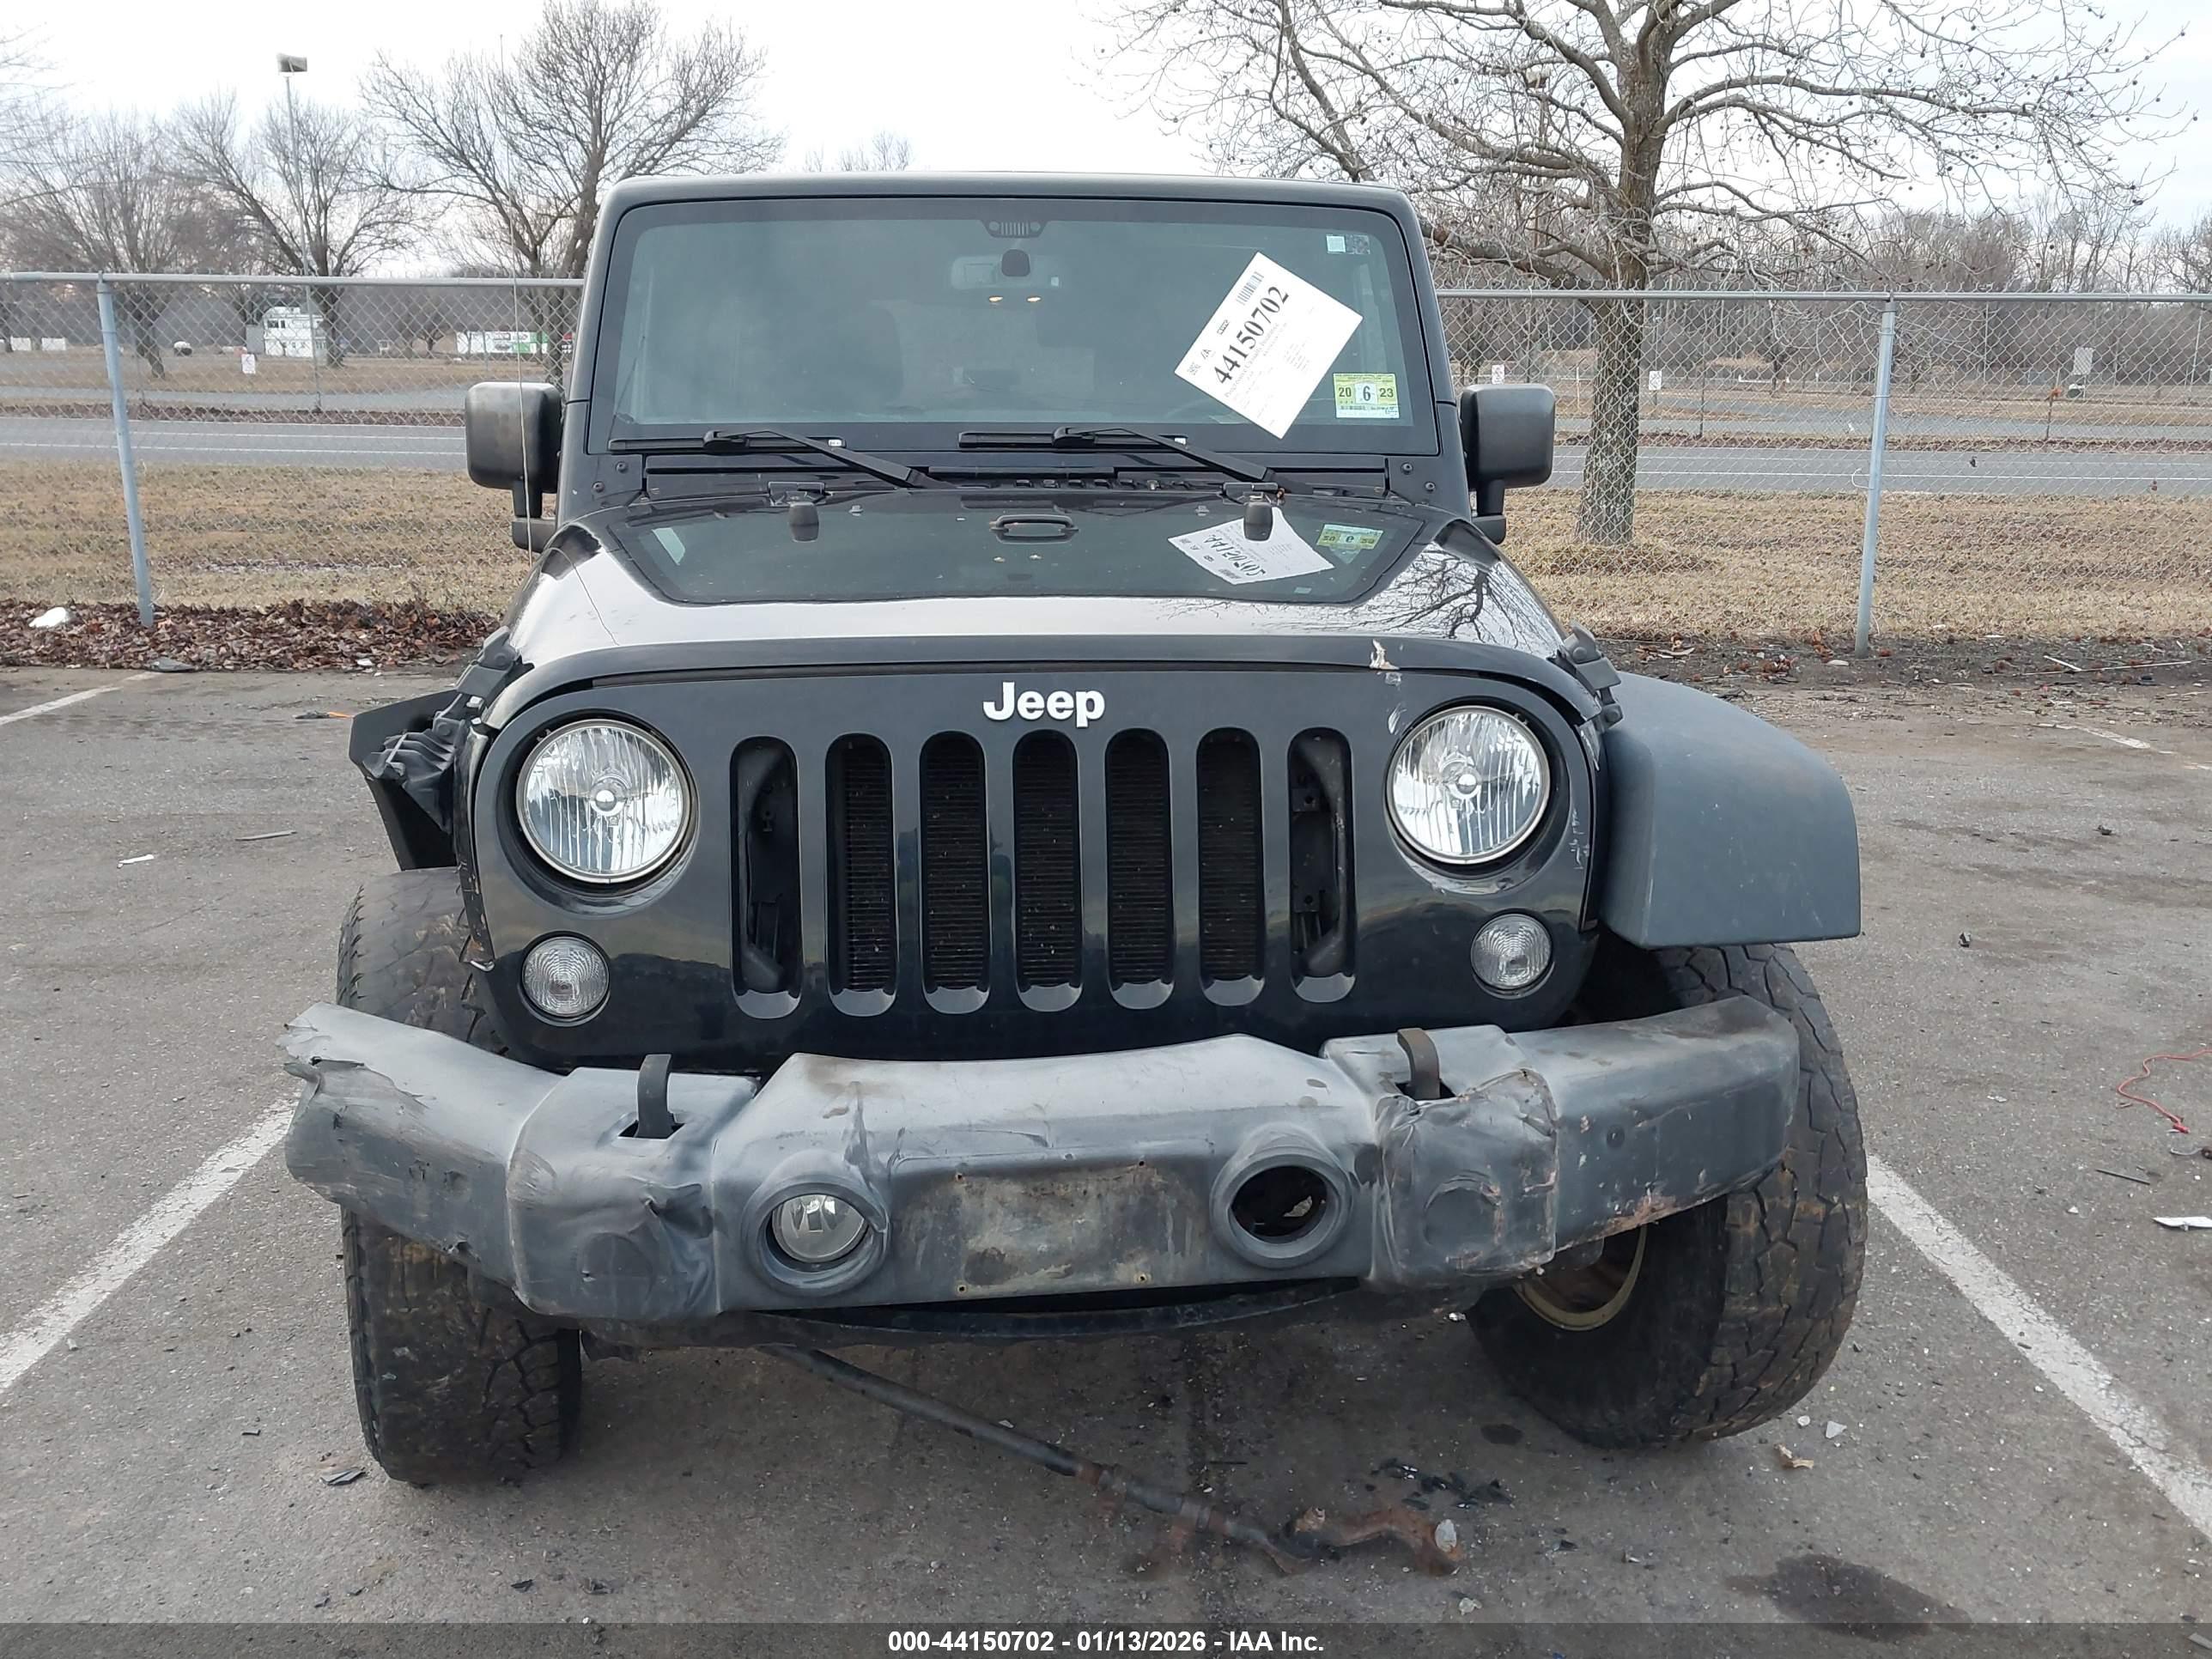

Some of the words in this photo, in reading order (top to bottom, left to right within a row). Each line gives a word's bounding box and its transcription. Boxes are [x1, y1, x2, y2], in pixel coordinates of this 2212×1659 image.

[1214, 286, 1289, 383] 44150702
[1339, 386, 1352, 398] 20
[1363, 386, 1371, 402] 6
[1379, 387, 1394, 398] 23
[982, 681, 1105, 728] Jeep
